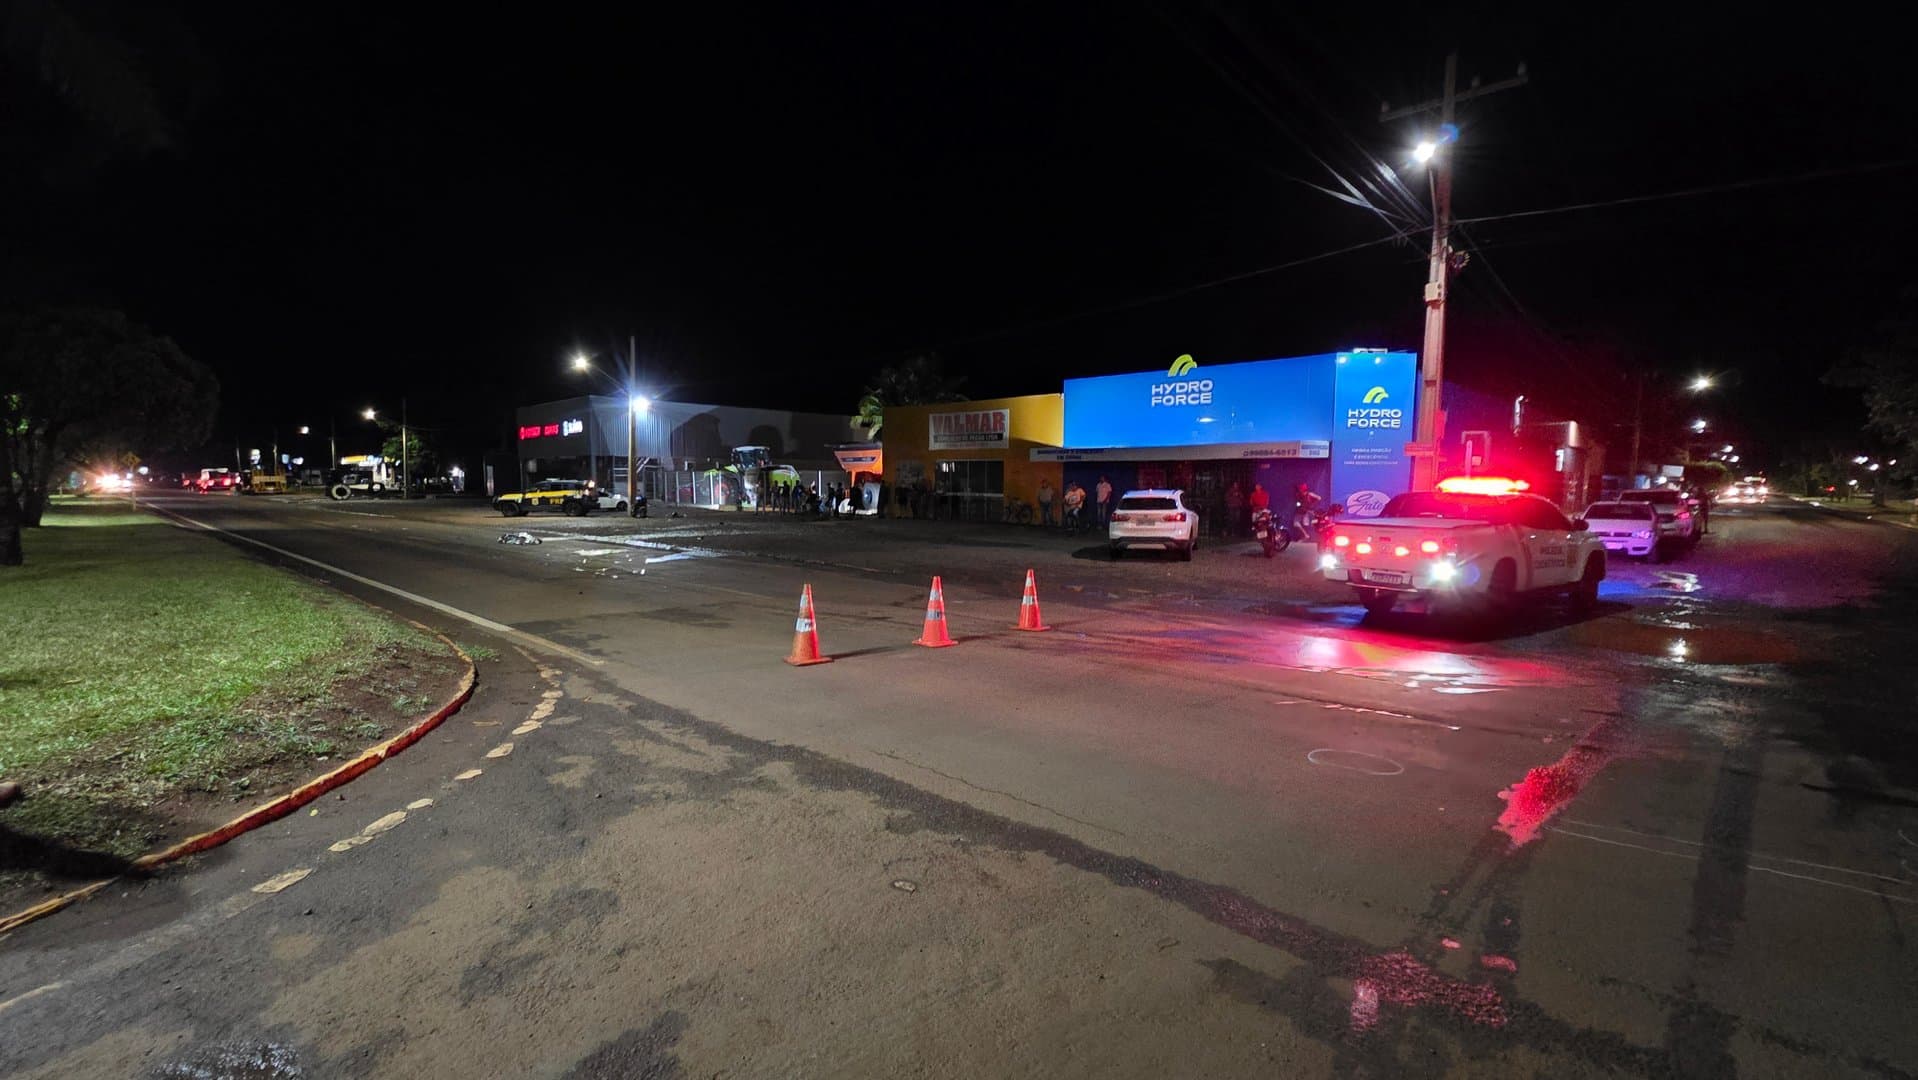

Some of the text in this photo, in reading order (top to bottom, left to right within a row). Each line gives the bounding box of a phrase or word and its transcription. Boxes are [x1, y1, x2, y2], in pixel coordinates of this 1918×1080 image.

[1152, 380, 1213, 395] HYDRO
[1152, 392, 1212, 407] FORCE
[1347, 408, 1402, 418] HYDRO
[1347, 419, 1401, 428] FORCE
